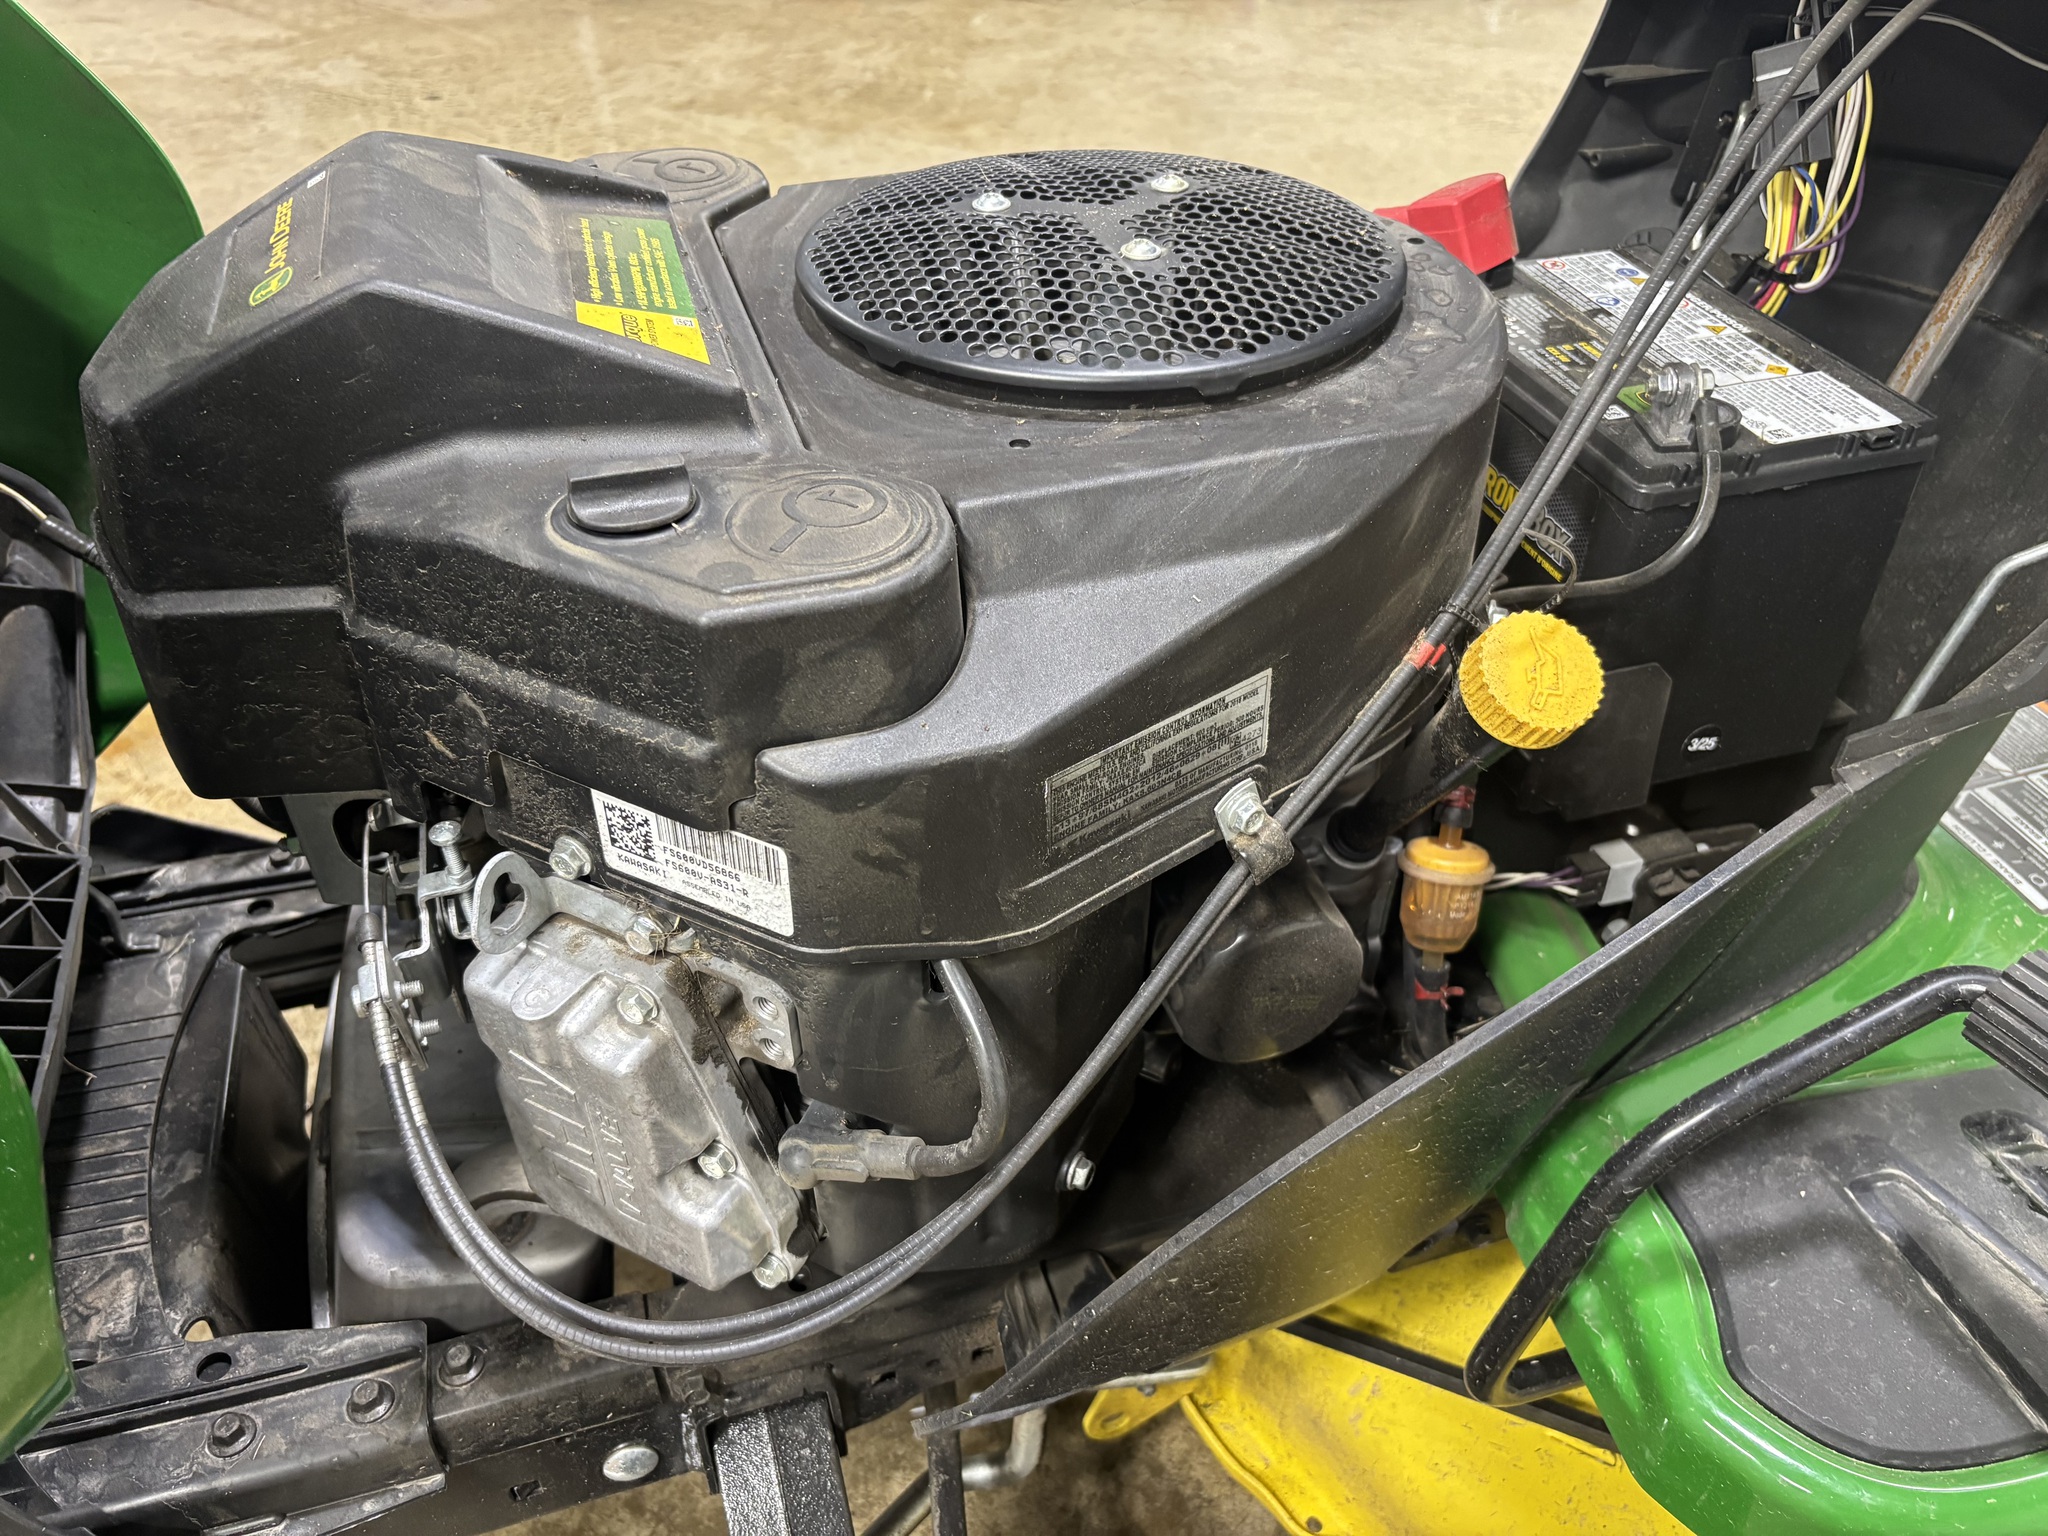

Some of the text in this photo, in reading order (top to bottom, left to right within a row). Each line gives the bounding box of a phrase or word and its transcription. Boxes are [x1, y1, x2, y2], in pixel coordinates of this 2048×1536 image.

[264, 197, 293, 274] JOHN DEERE
[1100, 695, 1225, 764] IMPORTANT EMISSION CONTROL INFORMATION
[1687, 736, 1718, 752] 3/25
[1119, 752, 1144, 770] ENGINES
[1188, 770, 1196, 780] OF
[1053, 818, 1085, 842] ENGINE
[1087, 799, 1121, 824] FAMILY:
[617, 853, 668, 879] KAWASAKI
[1990, 858, 2024, 885] BRAKE
[682, 879, 720, 900] ASSEMBLED
[725, 895, 734, 904] IN
